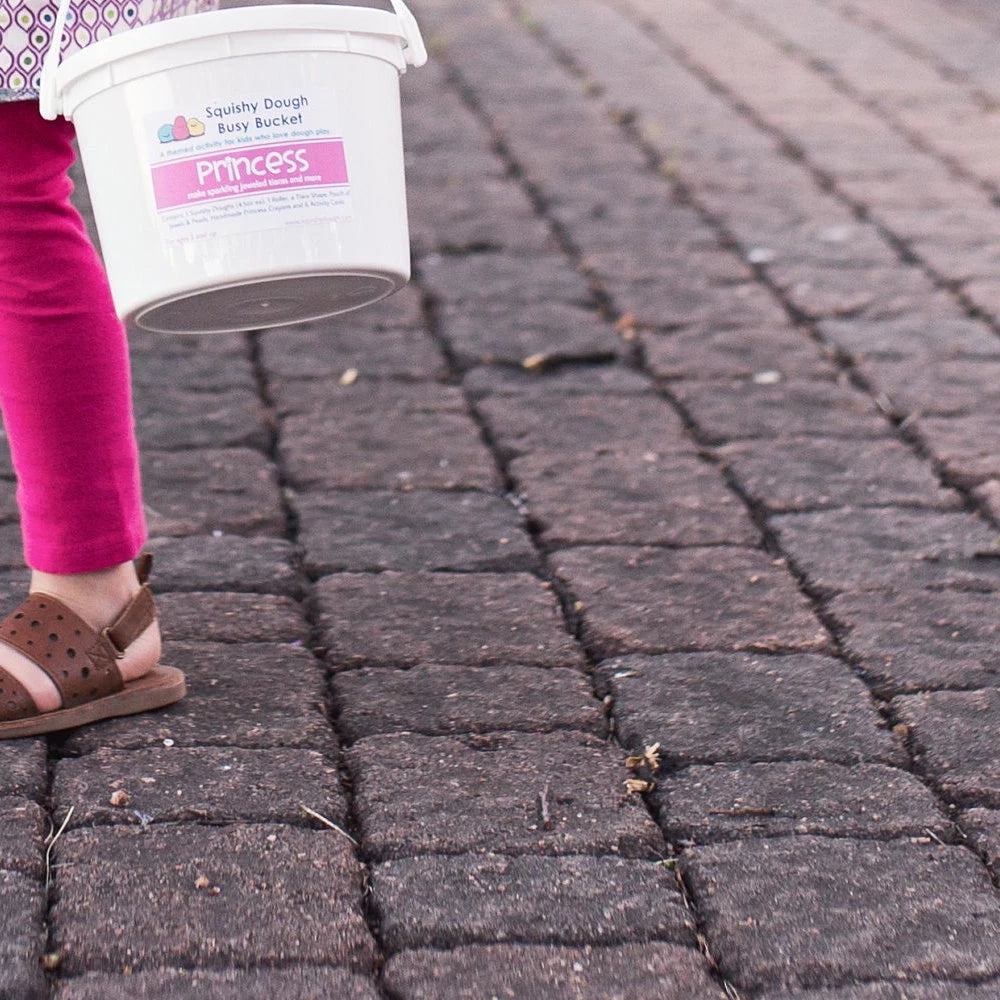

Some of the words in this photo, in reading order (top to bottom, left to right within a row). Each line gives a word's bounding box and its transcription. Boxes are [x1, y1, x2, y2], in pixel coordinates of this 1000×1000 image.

[205, 101, 258, 118] Squishy
[264, 94, 309, 110] Dough
[218, 121, 249, 134] Busy
[255, 113, 303, 129] Bucket
[195, 140, 221, 150] activity
[290, 129, 313, 137] dough
[196, 148, 310, 185] Princess
[207, 185, 240, 196] sparkling
[290, 175, 303, 183] and
